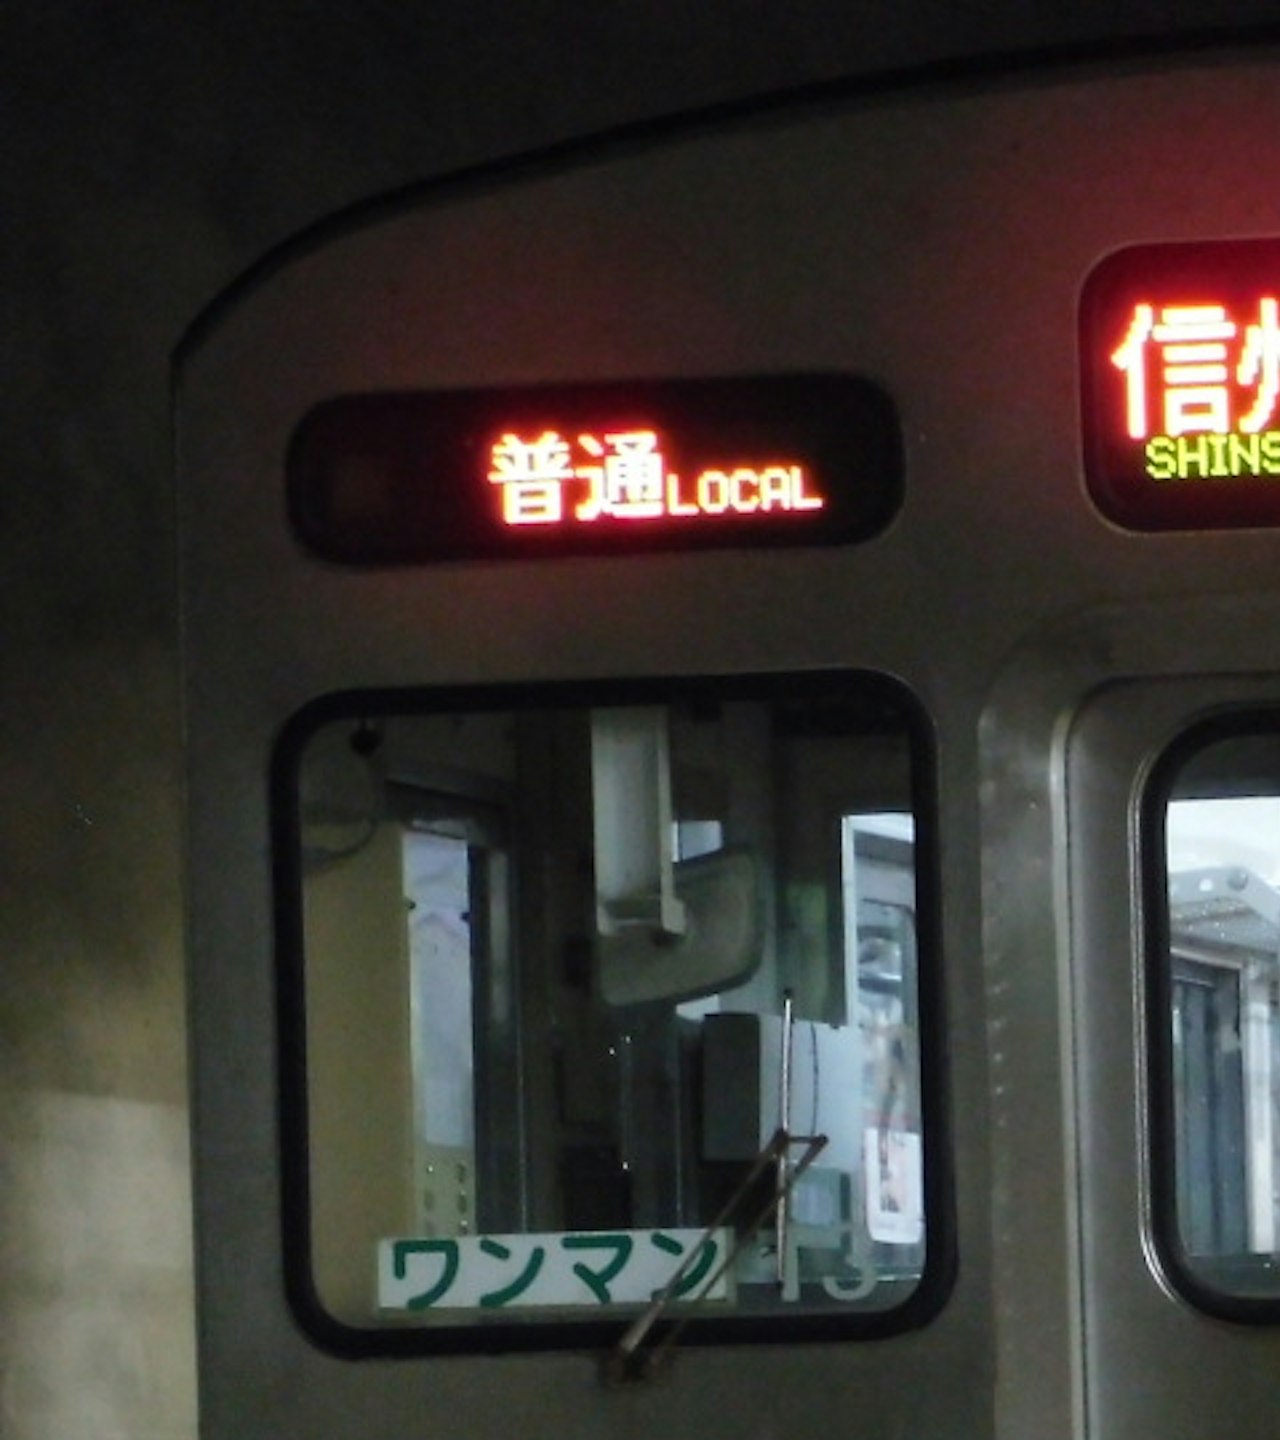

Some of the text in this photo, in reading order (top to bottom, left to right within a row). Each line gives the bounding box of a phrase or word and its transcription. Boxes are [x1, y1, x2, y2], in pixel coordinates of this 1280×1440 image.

[486, 430, 824, 526] 普通 LOCAL
[393, 1233, 717, 1312] ワンマン
